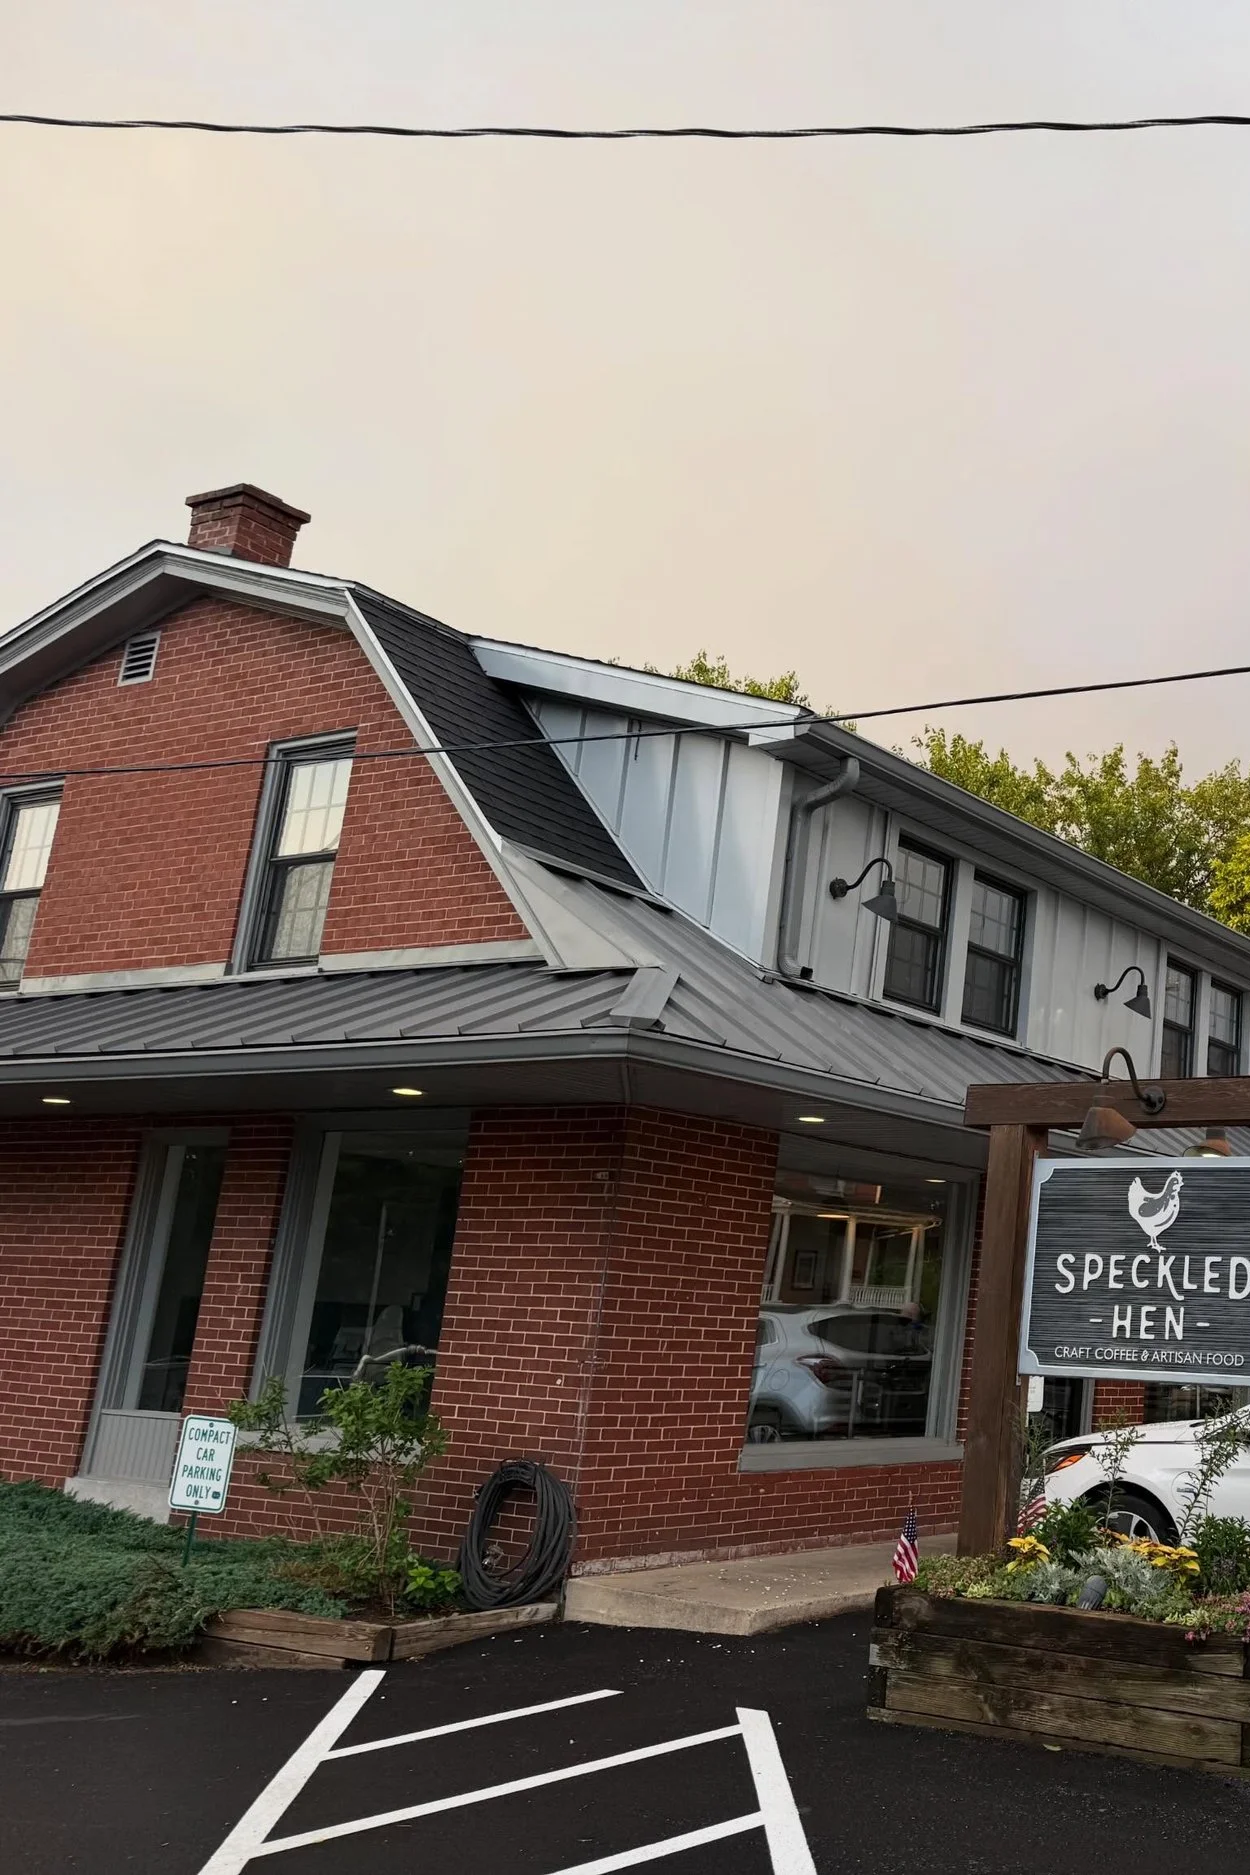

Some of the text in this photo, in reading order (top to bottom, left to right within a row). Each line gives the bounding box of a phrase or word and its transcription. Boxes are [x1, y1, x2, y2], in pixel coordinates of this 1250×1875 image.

[1054, 1346, 1245, 1366] CRAFT COFFEE & ARTISAN FOOD
[188, 1428, 231, 1444] COMPACT
[196, 1447, 215, 1462] CAR
[181, 1465, 222, 1482] PARKING
[185, 1484, 211, 1499] ONLY
